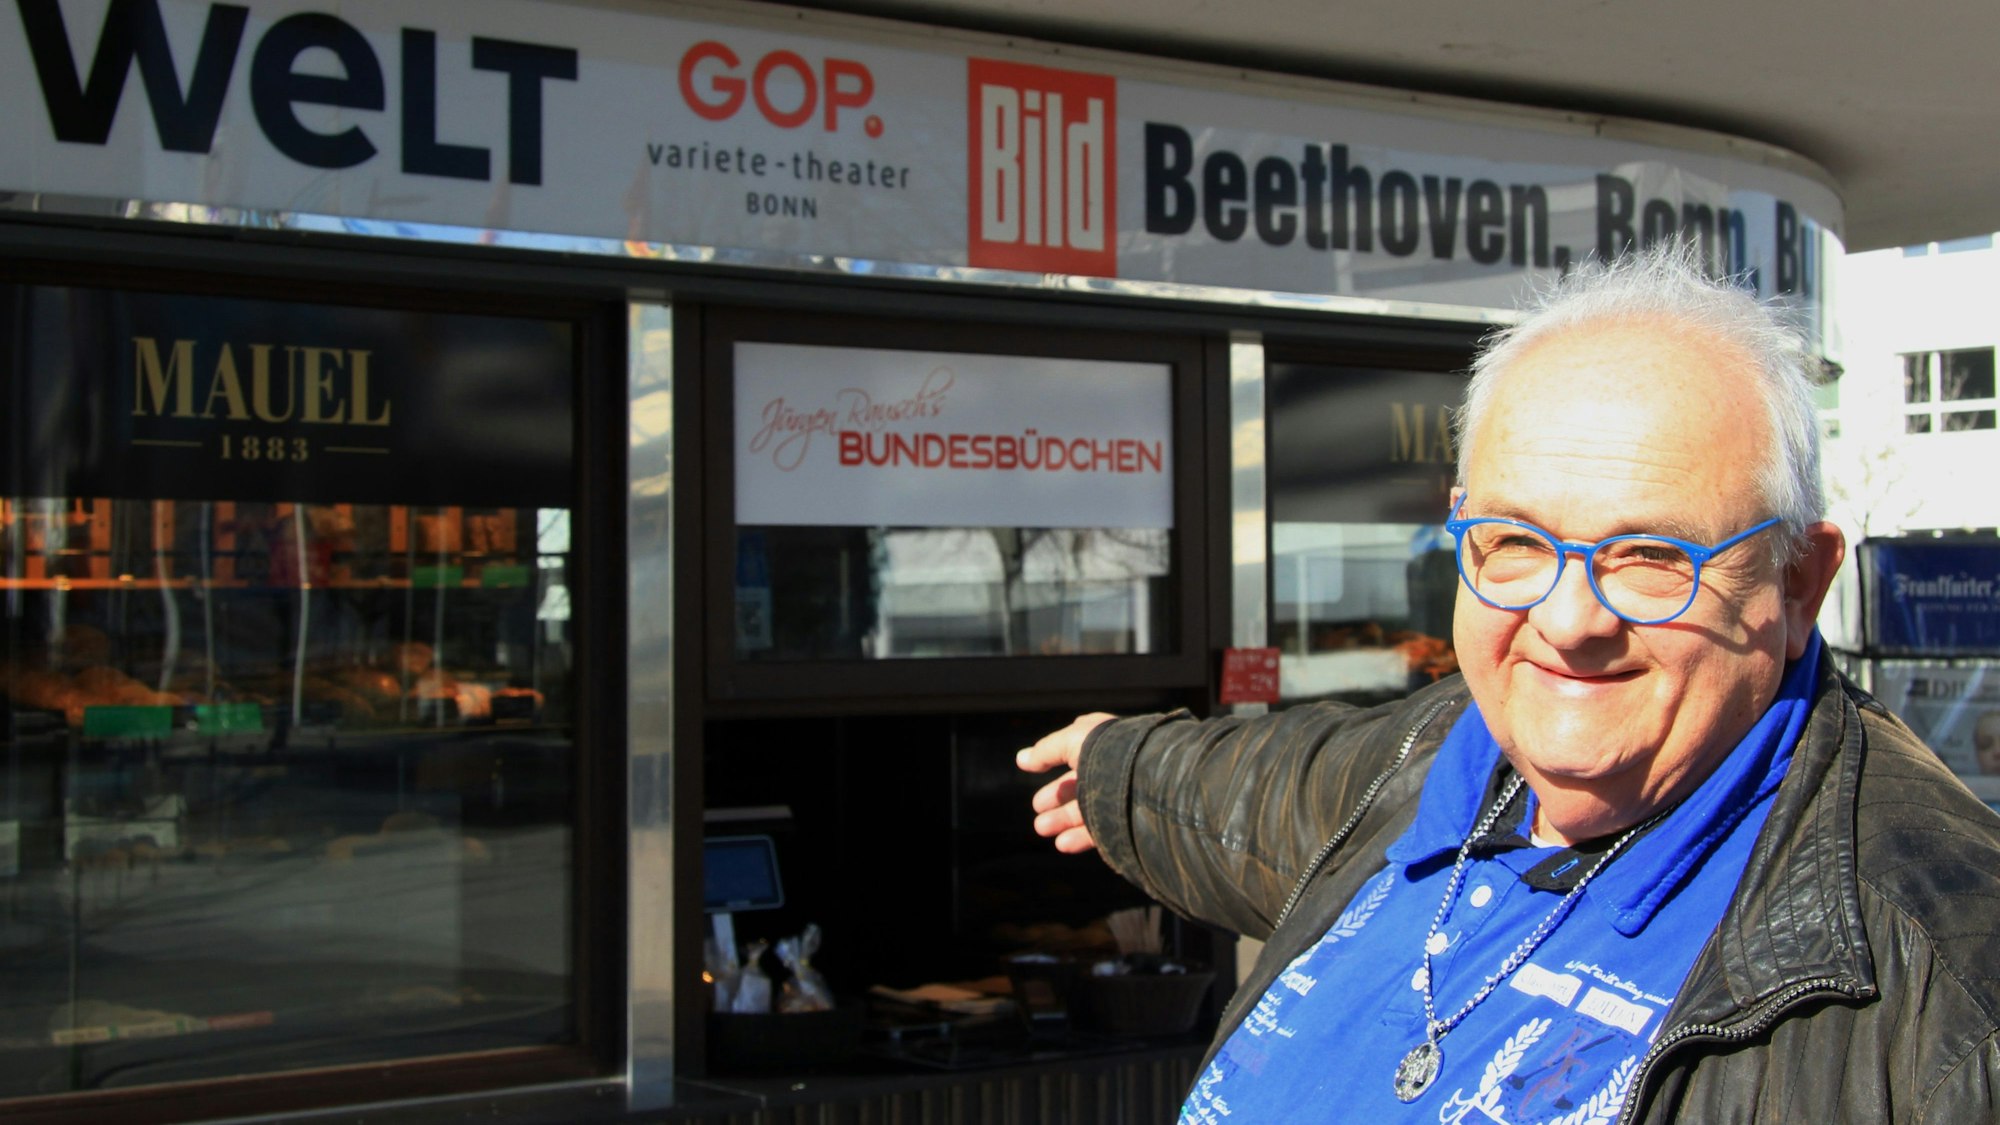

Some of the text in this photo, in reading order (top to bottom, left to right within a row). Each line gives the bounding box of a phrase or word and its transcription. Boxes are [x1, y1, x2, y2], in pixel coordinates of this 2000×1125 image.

[677, 40, 884, 138] GOP.
[647, 143, 911, 190] variete-theater
[981, 83, 1105, 252] Bild
[746, 192, 818, 219] BONN
[131, 336, 392, 427] MAUEL
[219, 433, 310, 462] 1883
[838, 428, 1163, 473] BUNDESBÜDCHEN
